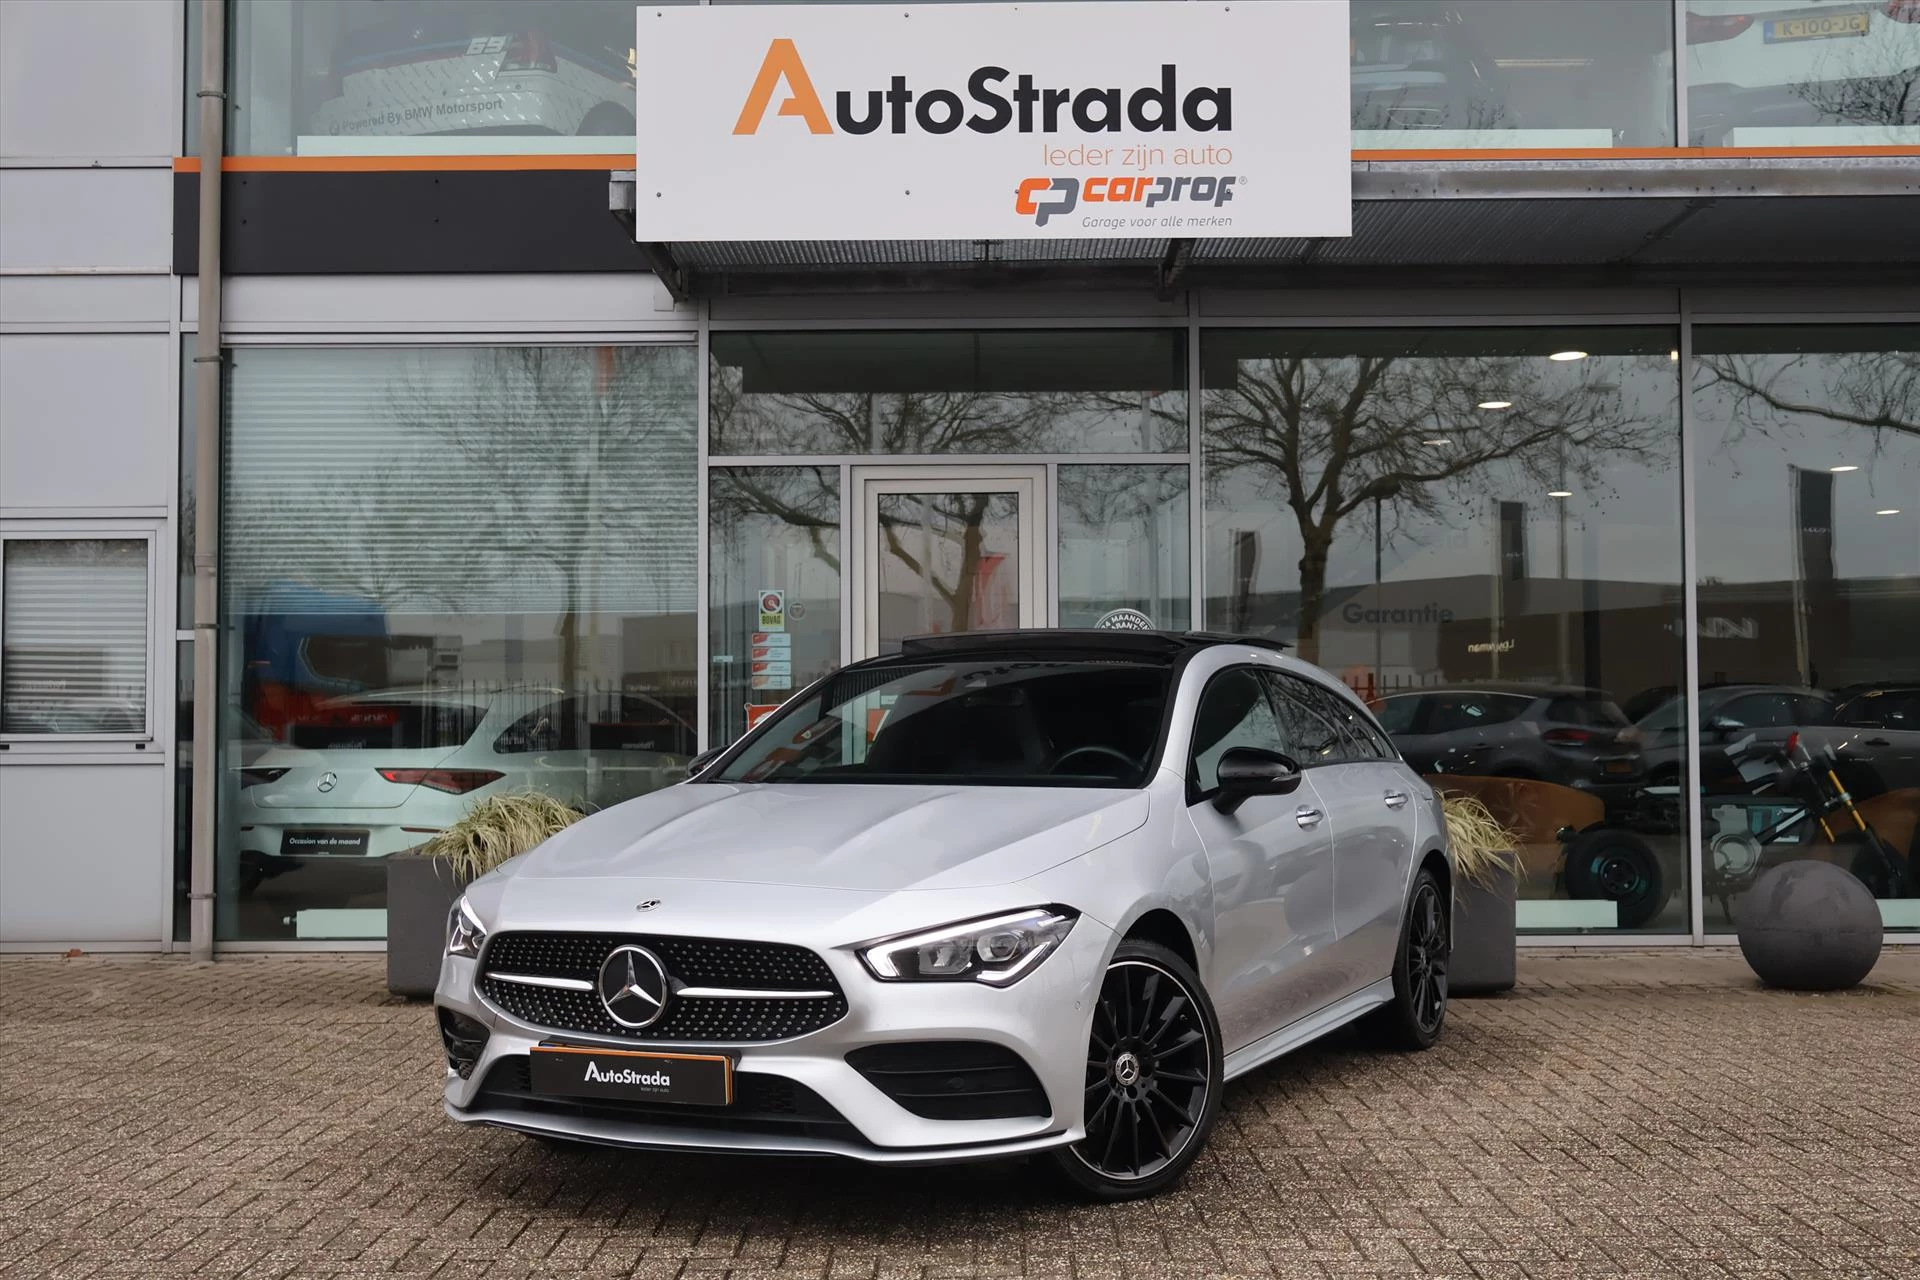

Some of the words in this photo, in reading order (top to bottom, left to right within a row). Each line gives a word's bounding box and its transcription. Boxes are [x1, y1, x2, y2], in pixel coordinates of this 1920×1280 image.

[732, 38, 1232, 136] AutoStrada
[342, 115, 385, 132] Powered
[387, 112, 401, 124] By
[405, 106, 434, 121] BMW
[436, 100, 503, 116] Motorsport
[1044, 144, 1113, 166] Ieder
[1122, 145, 1164, 171] zijn
[1174, 147, 1233, 165] auto
[1082, 216, 1126, 230] Garage
[1130, 218, 1157, 228] voor
[1160, 216, 1185, 227] alle
[1187, 216, 1233, 227] merken
[1342, 601, 1454, 624] Garantie
[584, 1060, 671, 1086] AutoStrada
